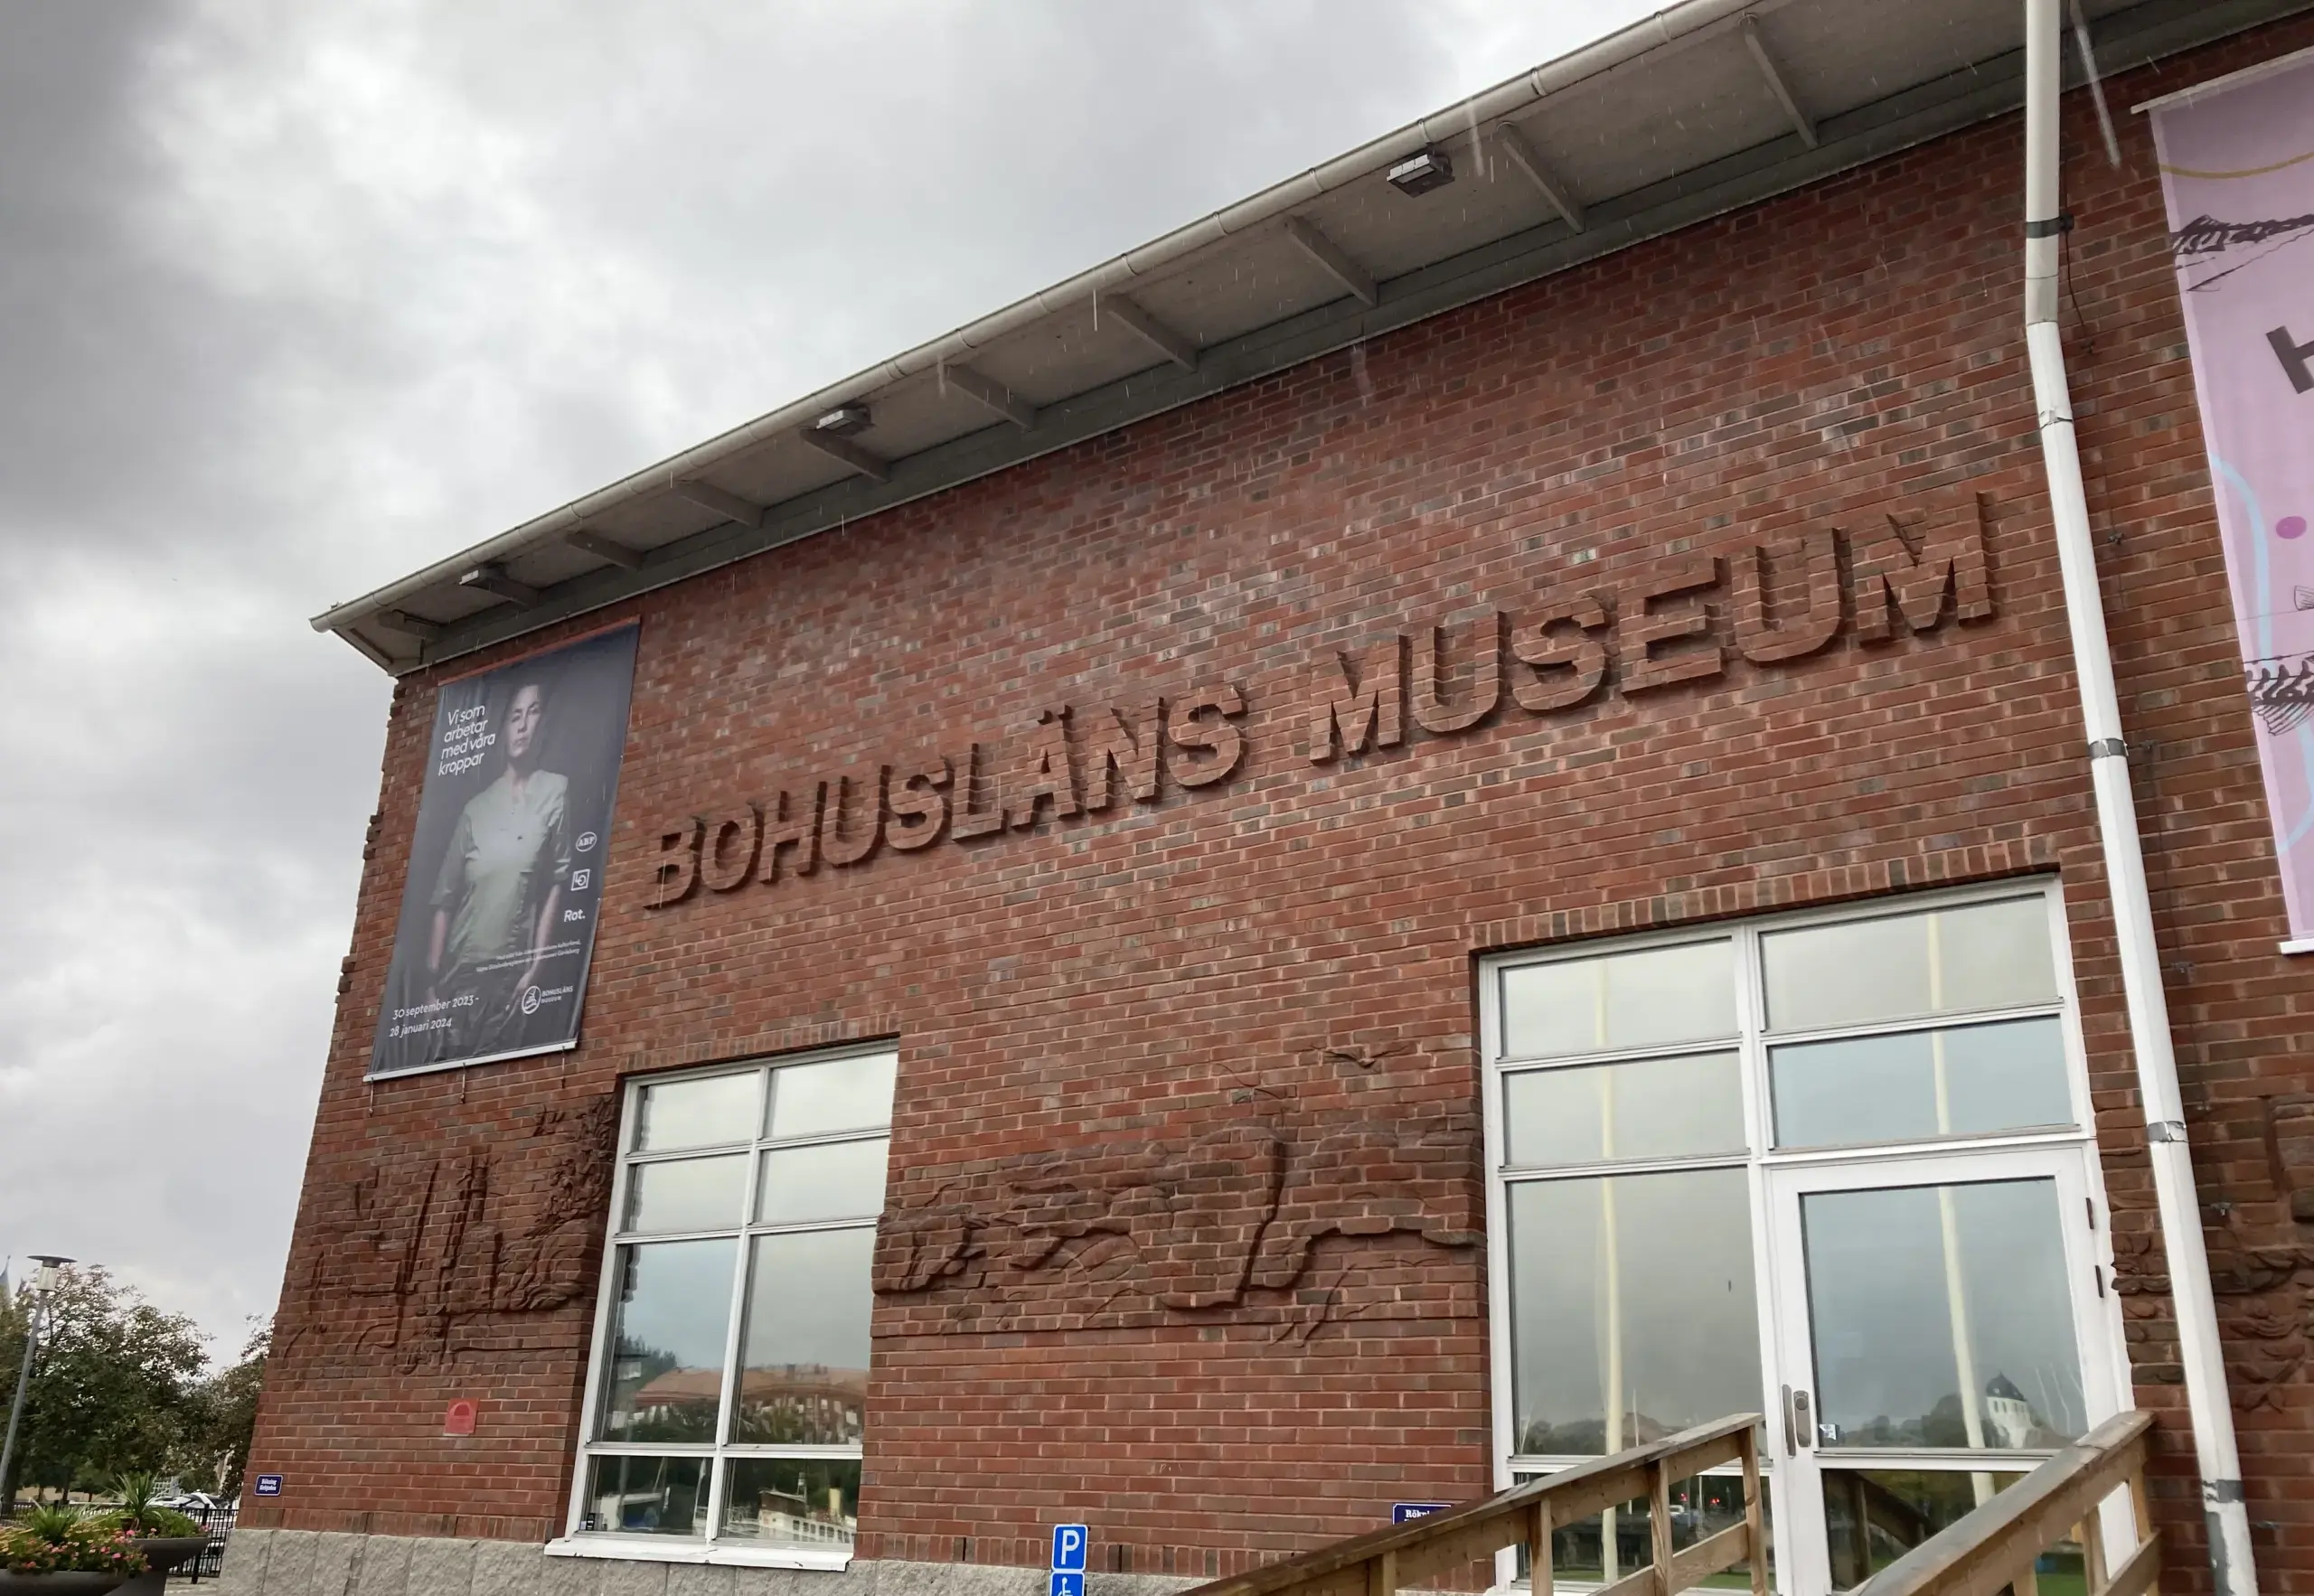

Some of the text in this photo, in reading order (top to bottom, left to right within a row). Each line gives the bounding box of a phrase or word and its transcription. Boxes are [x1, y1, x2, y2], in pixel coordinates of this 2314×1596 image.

[1308, 490, 1994, 768] MUSEUM
[447, 705, 486, 727] Vi som
[444, 719, 489, 743] arbetar
[441, 732, 496, 760] med våra
[437, 752, 485, 776] kroppar
[563, 908, 586, 923] Rot.
[391, 1009, 405, 1020] 30
[405, 998, 452, 1019] september
[451, 994, 475, 1008] 2023
[389, 1017, 453, 1038] 28 januari 2024
[1060, 1529, 1080, 1565] P
